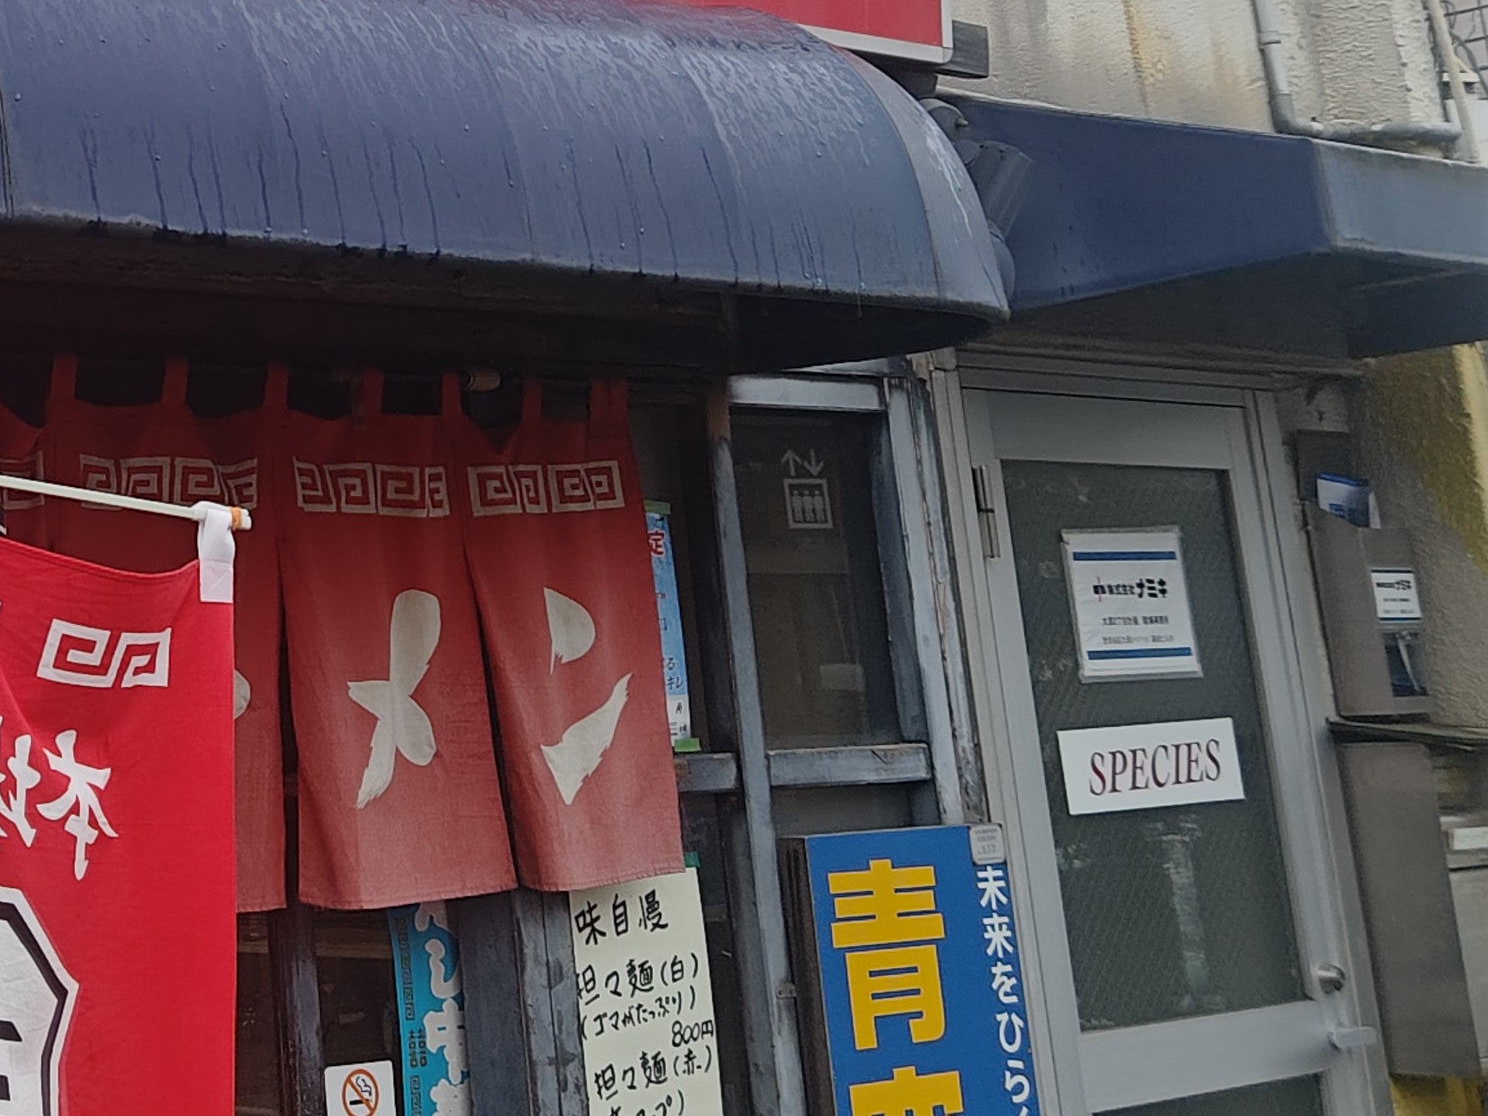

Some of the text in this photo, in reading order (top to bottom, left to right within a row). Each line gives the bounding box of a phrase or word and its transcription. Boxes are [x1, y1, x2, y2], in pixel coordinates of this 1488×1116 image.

[234, 588, 633, 810] メン
[1089, 738, 1221, 796] SPECIES
[573, 888, 669, 945] 味自慢
[828, 858, 964, 1116] 青
[671, 1019, 713, 1047] 800円
